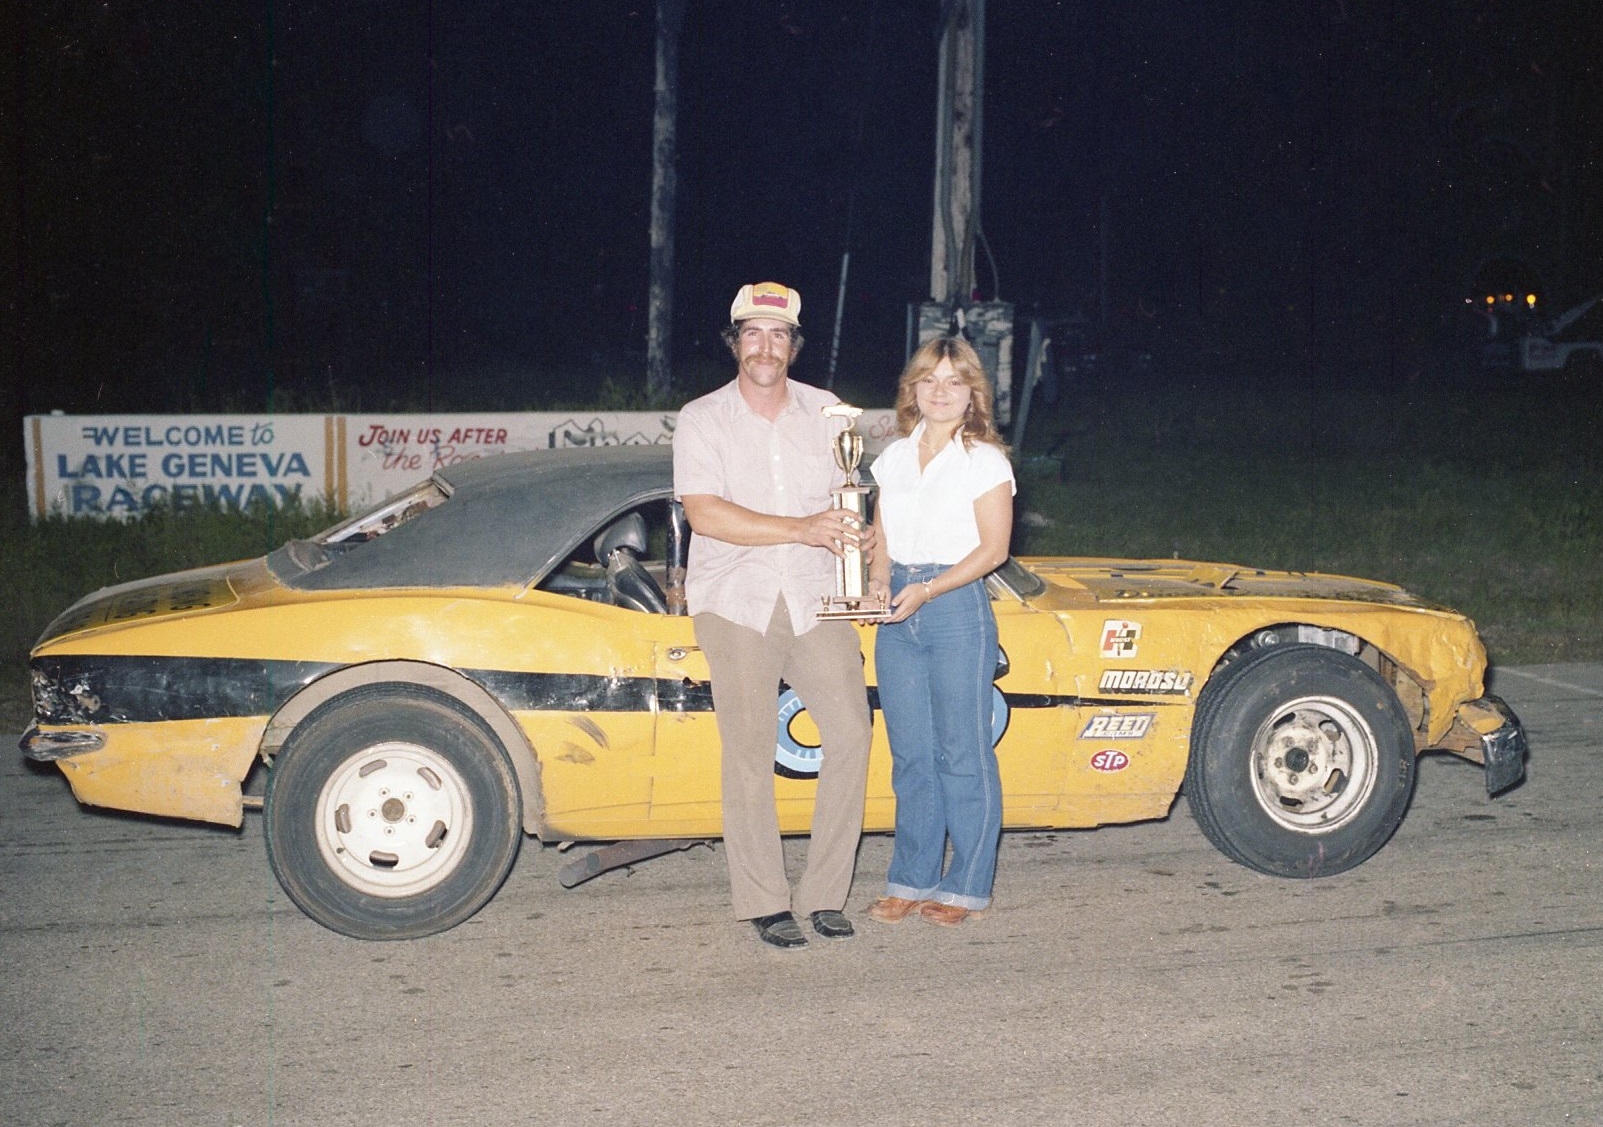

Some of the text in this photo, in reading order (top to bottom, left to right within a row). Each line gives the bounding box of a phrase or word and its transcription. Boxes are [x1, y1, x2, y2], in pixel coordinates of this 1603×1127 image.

[83, 422, 275, 447] WELCOME to
[358, 425, 508, 446] JOIN US AFTER
[57, 453, 312, 478] LAKE GENEVA
[383, 446, 422, 470] the
[1098, 669, 1191, 693] MOROSO
[1084, 715, 1153, 737] REED
[1093, 751, 1126, 769] STP
